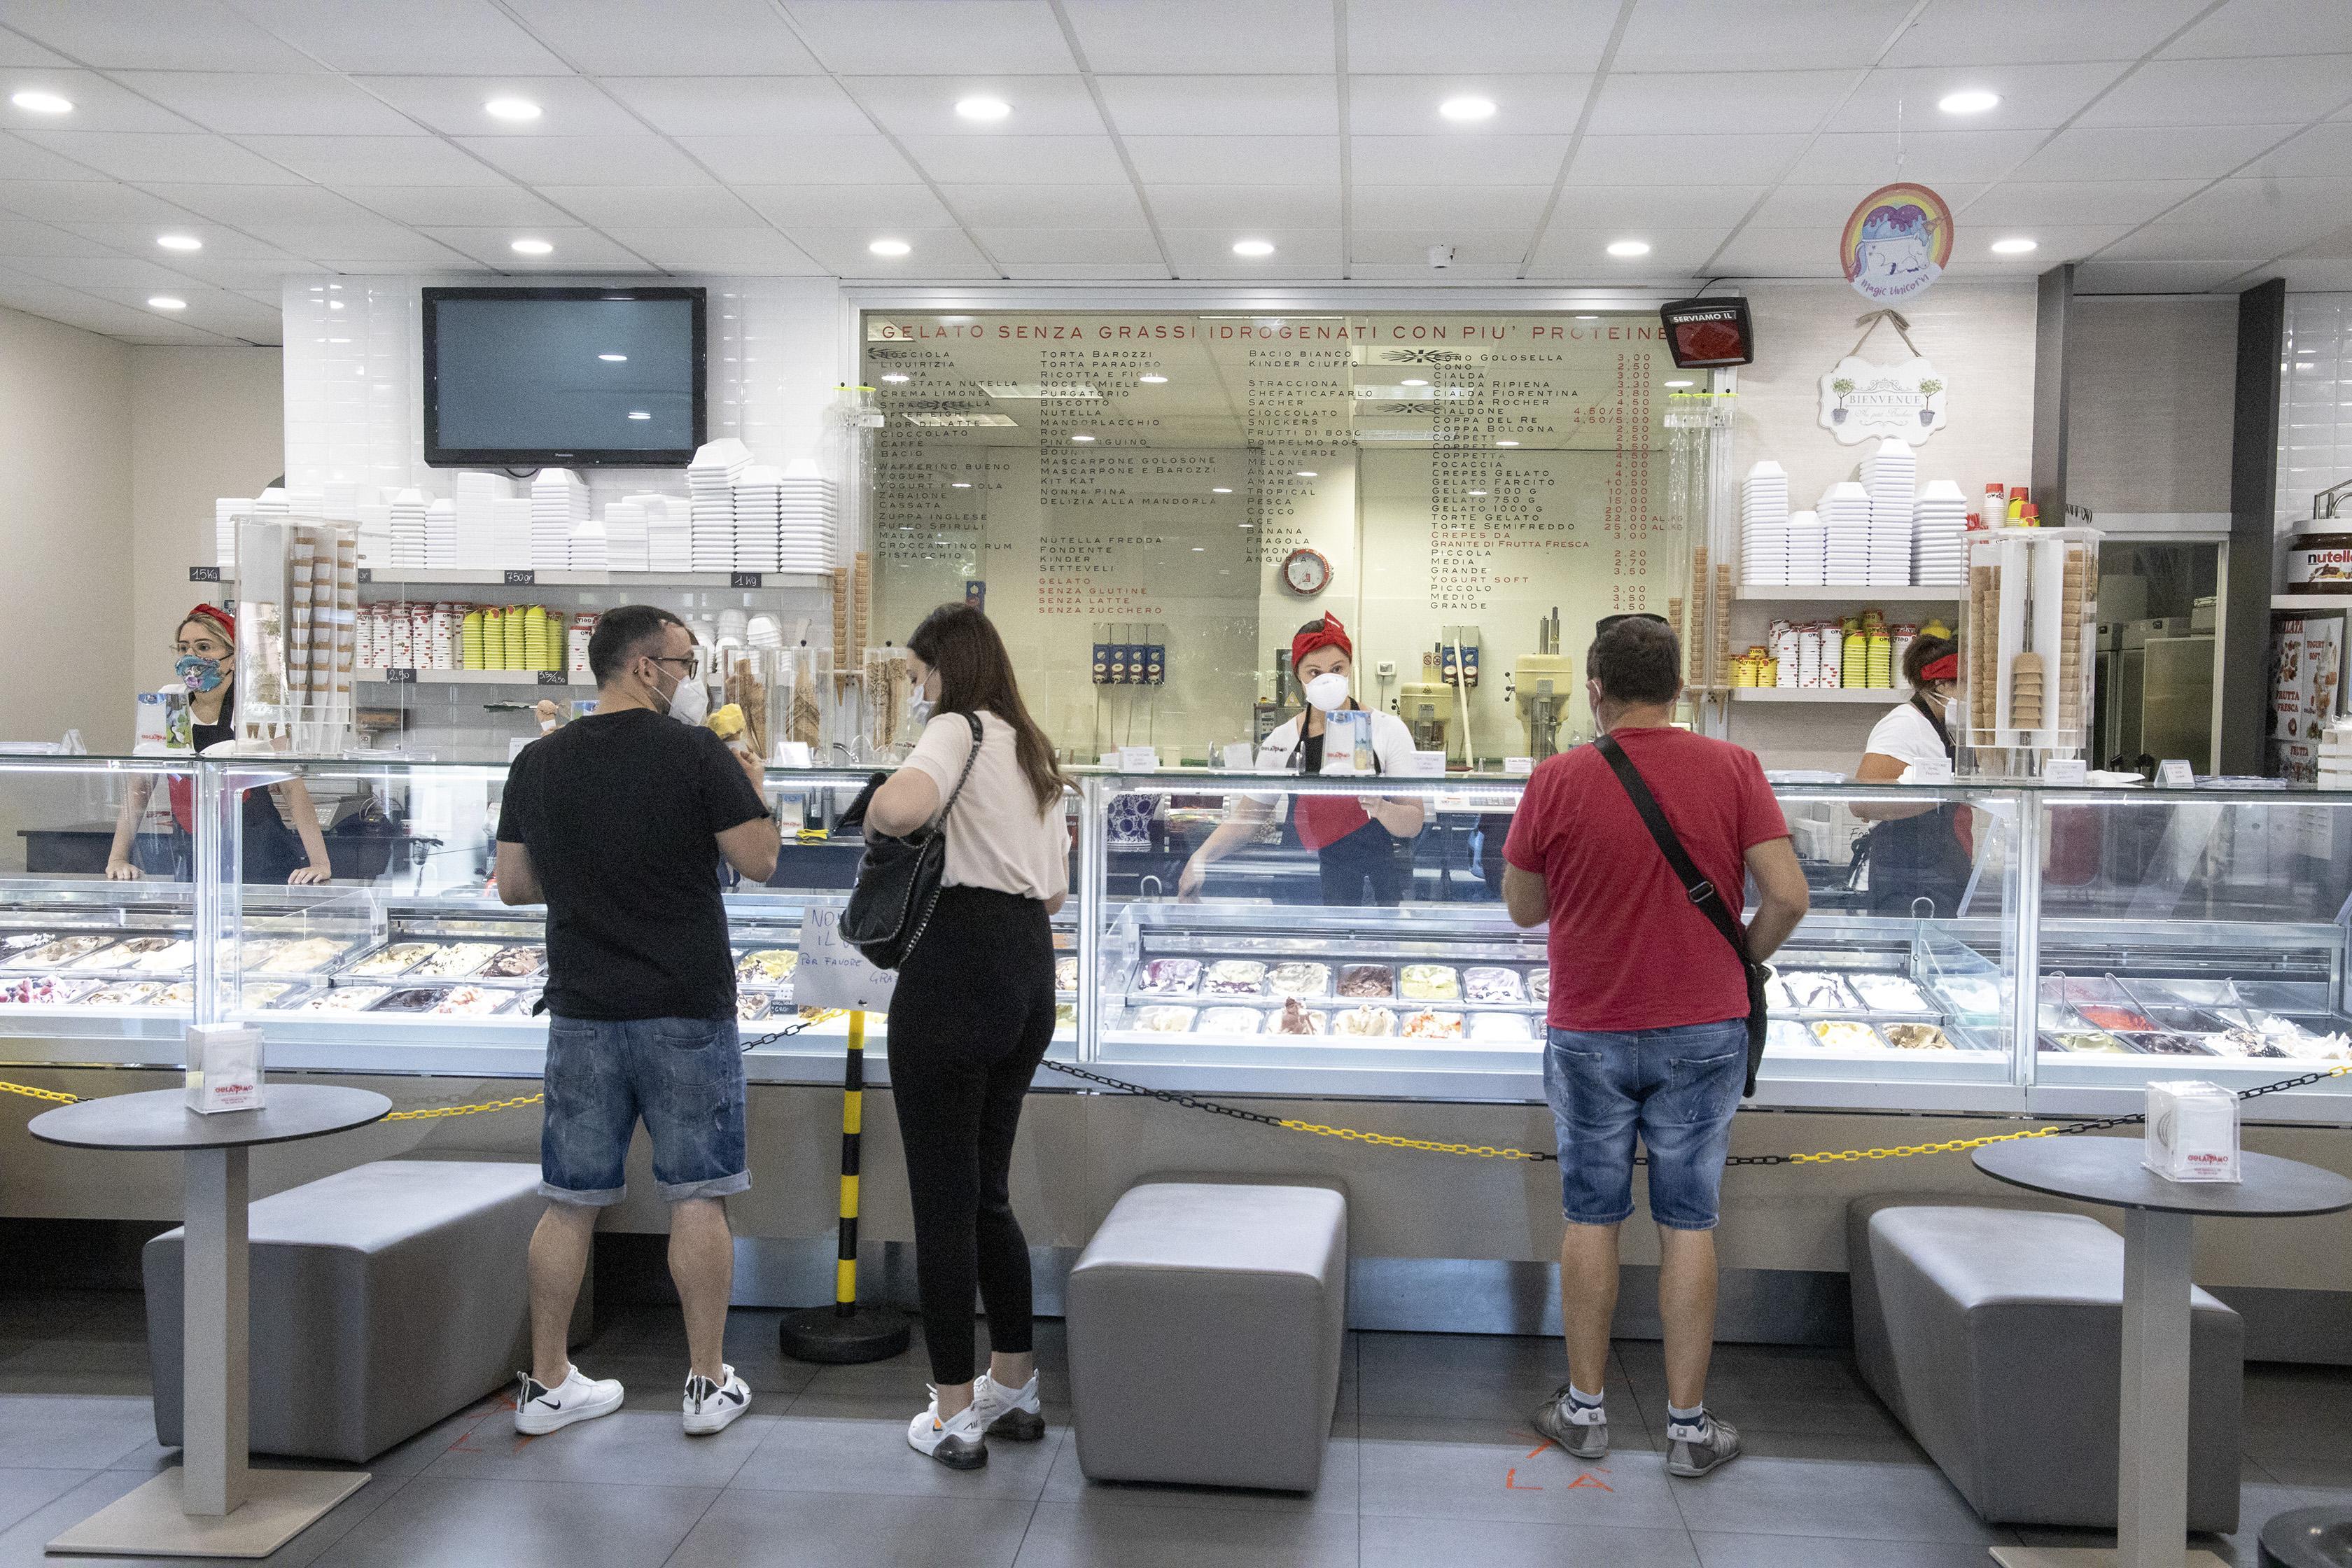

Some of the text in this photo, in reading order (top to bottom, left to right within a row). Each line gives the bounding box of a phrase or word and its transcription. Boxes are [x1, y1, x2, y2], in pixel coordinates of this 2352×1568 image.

[1674, 314, 1721, 323] SERVIAMO
[882, 326, 983, 340] GELATO
[998, 326, 1082, 339] SENZA
[1099, 326, 1196, 339] GRASSI
[1210, 326, 1378, 340] IDROGENATI
[1393, 326, 1447, 339] CON
[1850, 396, 1921, 404] BIENVENUE
[2308, 550, 2352, 563] nutell
